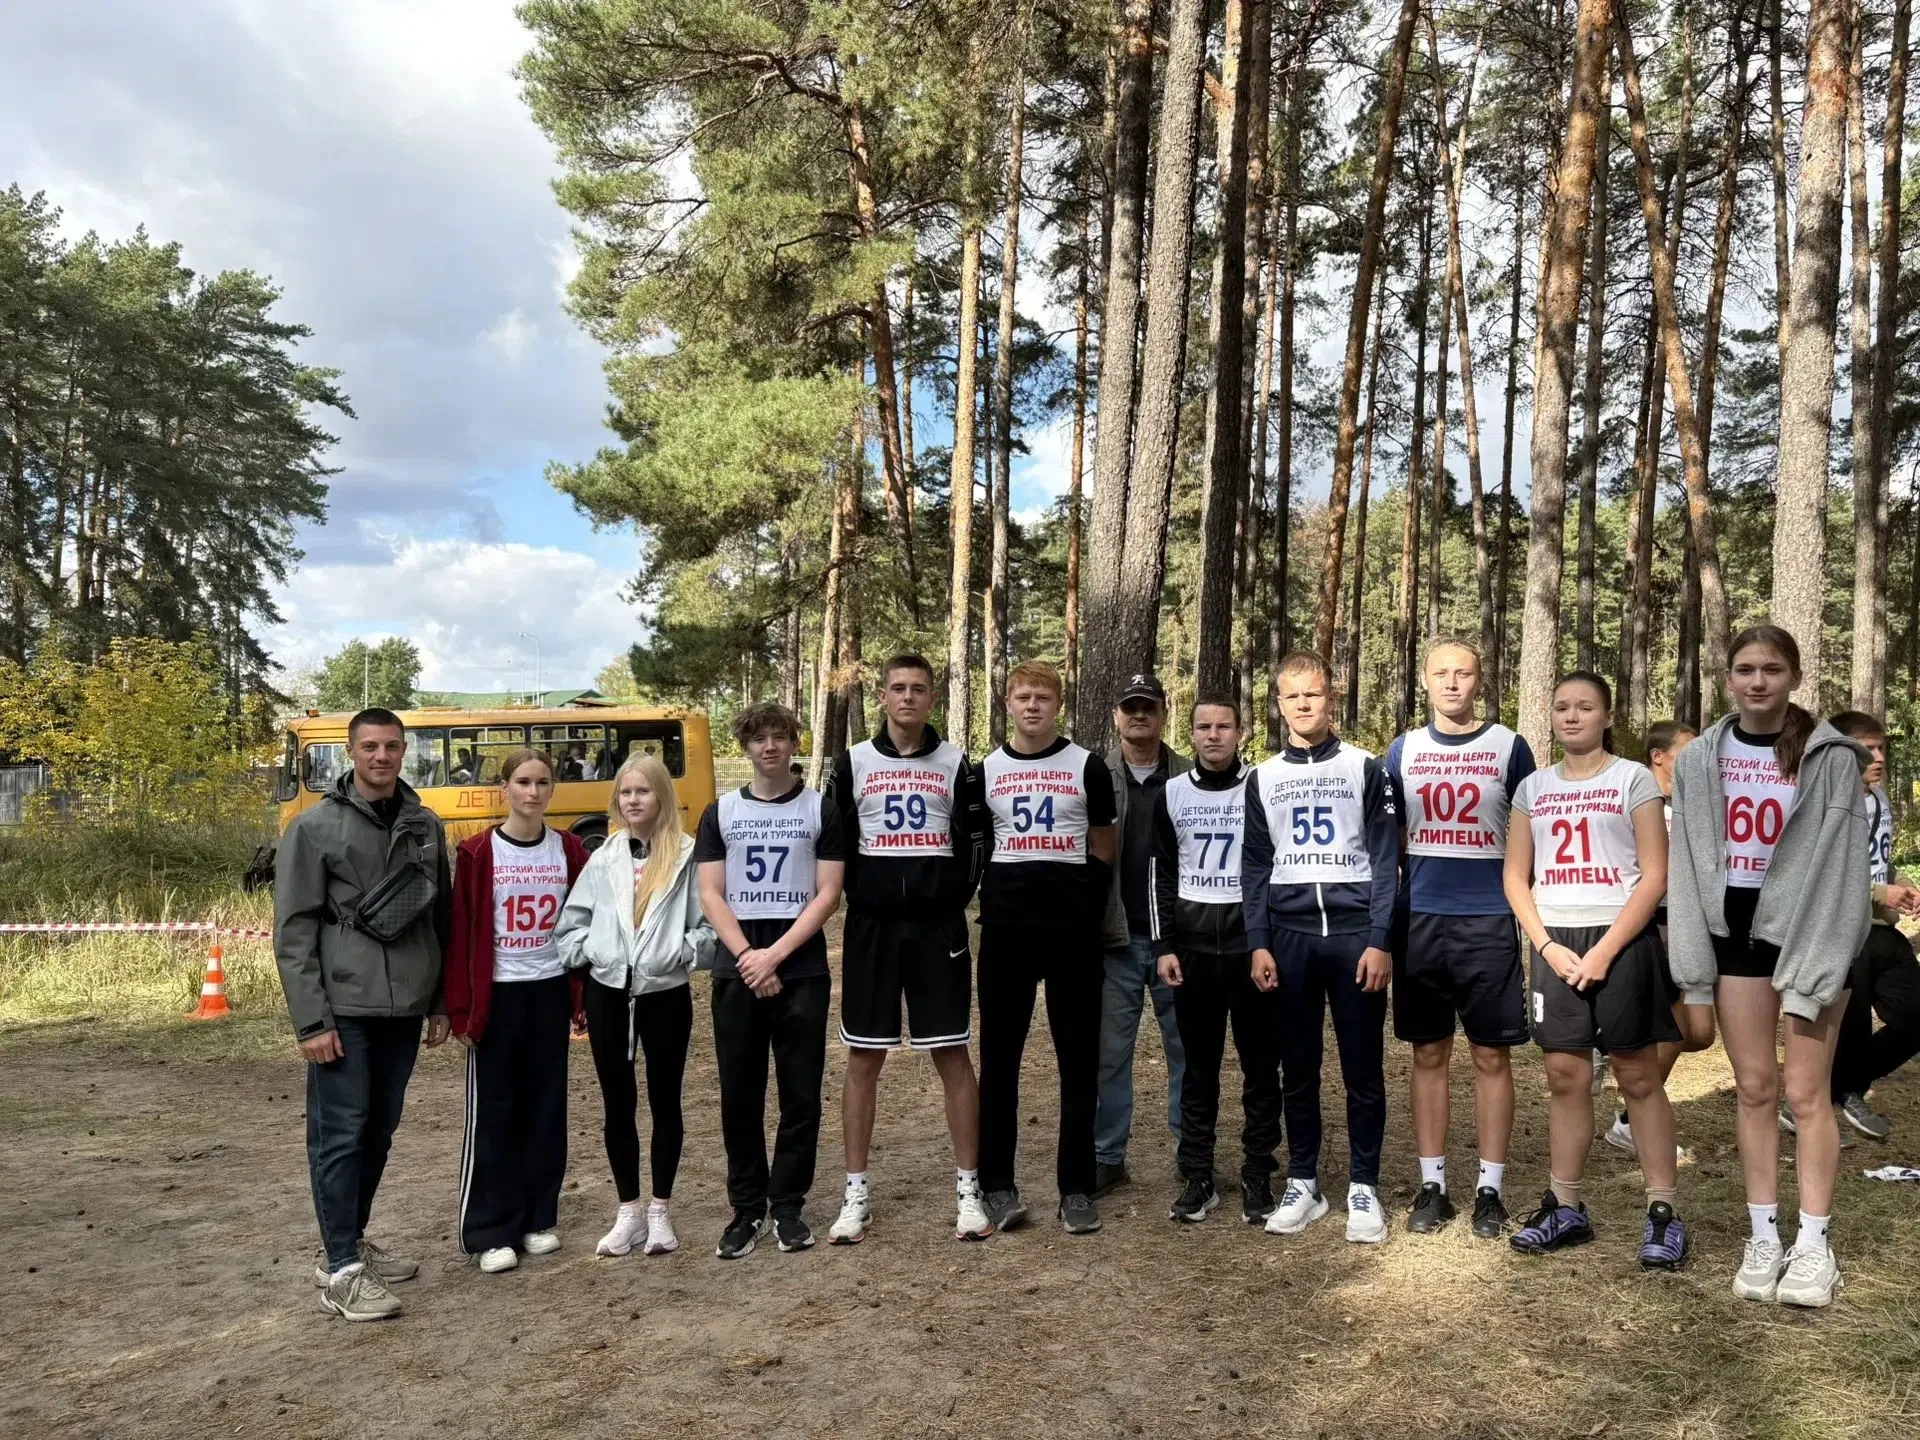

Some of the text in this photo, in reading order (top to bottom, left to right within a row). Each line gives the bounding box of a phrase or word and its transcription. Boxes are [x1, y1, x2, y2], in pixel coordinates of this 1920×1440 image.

[1414, 751, 1497, 764] ДЕТСКИЙ ЦЕНТР
[1718, 757, 1760, 770] ЕТСКИЙ
[866, 768, 945, 784] ДЕТСКИЙ ЦЕНТР
[995, 769, 1073, 786] ДЕТСКИЙ ЦЕНТР
[1407, 766, 1499, 777] СПОРТА И ТУРИЗМА
[1720, 772, 1740, 782] РТА
[1743, 773, 1752, 782] И
[861, 783, 949, 798] СПОРТА И ТУРИЗМА
[990, 783, 1079, 798] СПОРТА И ТУРИЗМА
[1274, 777, 1347, 793] ДЕТСКИЙ ЦЕНТР
[1270, 790, 1355, 806] СПОРТА И ТУРИЗМА
[1416, 781, 1480, 824] 102
[1535, 788, 1619, 806] ДЕТСКИЙ ЦЕНТР
[884, 794, 927, 831] 59
[1012, 796, 1055, 833] 54
[1182, 805, 1245, 816] ДЕТСКИЙ ЦЕНТ
[1529, 803, 1623, 819] СПОРТА И ТУРИЗМА
[731, 818, 805, 829] ДЕТСКИЙ ЦЕНТР
[1177, 817, 1245, 827] СПОРТА И ТУРИ
[1292, 806, 1335, 846] 55
[727, 830, 811, 841] СПОРТА И ТУРИЗМА
[1551, 817, 1591, 865] 21
[1194, 833, 1234, 870] 77
[745, 845, 790, 883] 57
[1282, 853, 1357, 868] ЛИПЕЦК
[493, 864, 562, 875] ДЕТСКИЙ ЦЕНТР
[1540, 867, 1622, 886] .ЛИПЕЦК
[494, 876, 521, 886] ПОРТА
[1191, 875, 1242, 888] ЛИПЕ
[738, 891, 809, 904] ЛИПЕЦК
[502, 894, 557, 932] 152
